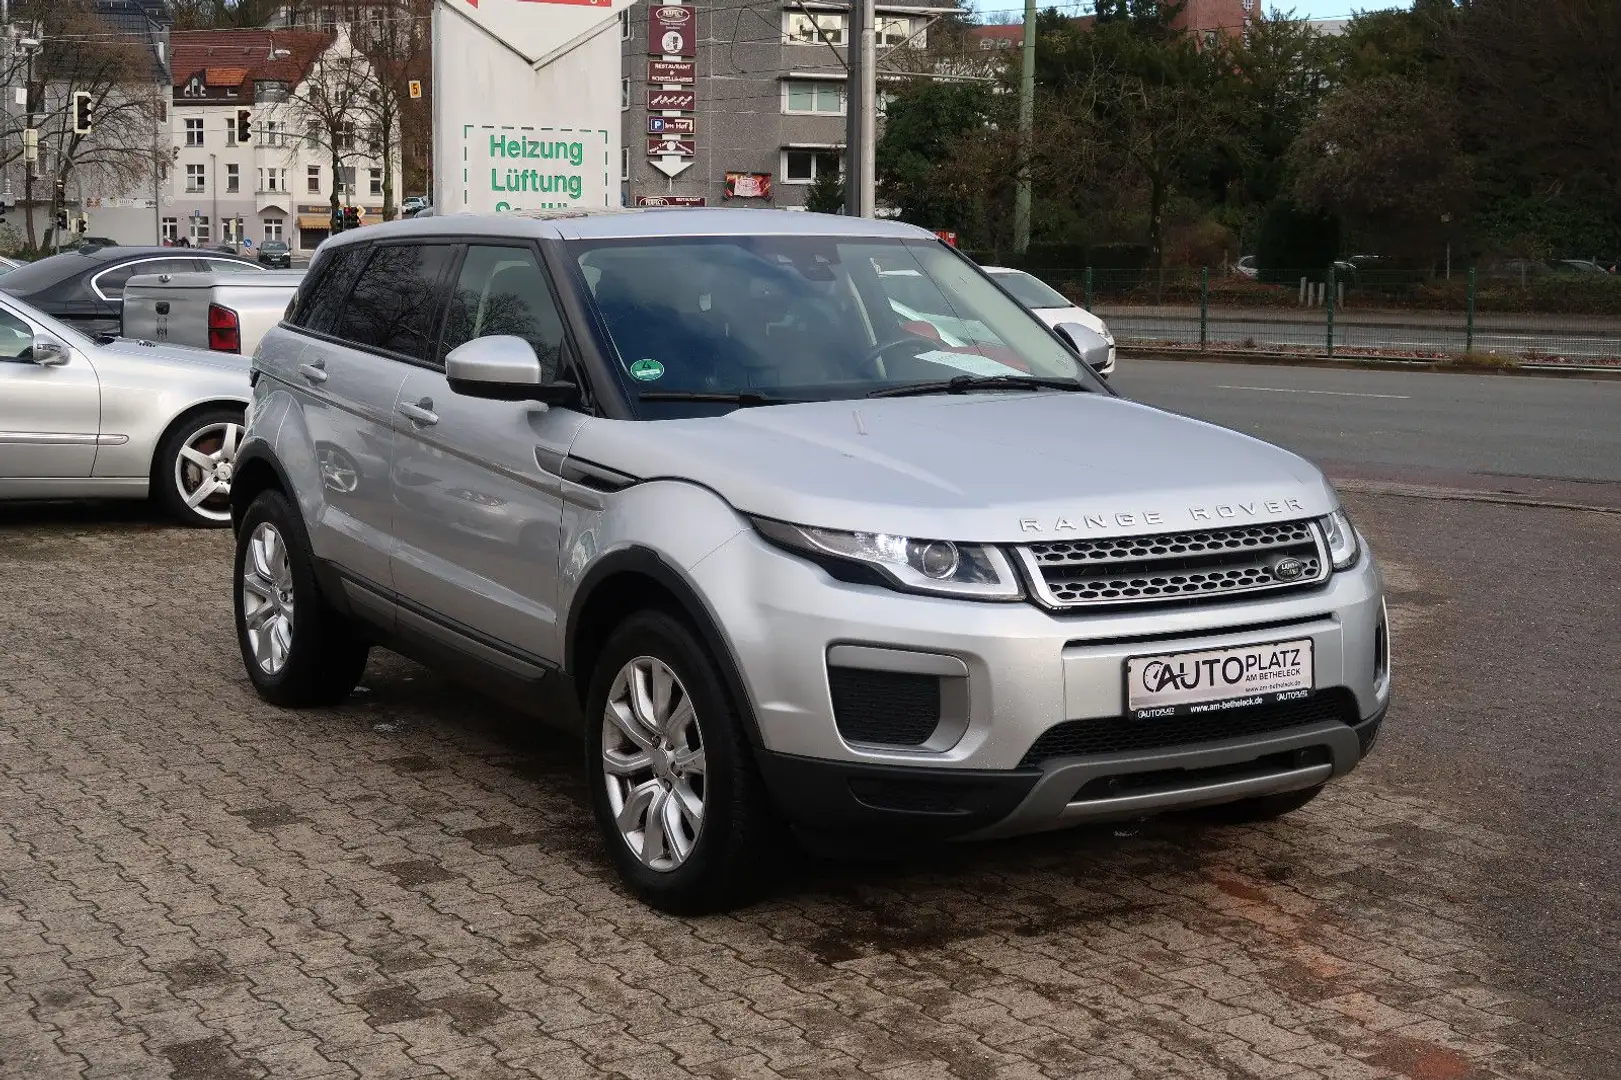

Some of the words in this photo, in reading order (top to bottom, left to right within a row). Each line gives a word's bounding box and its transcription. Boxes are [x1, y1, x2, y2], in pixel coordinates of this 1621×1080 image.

[489, 134, 583, 166] Heizung
[491, 168, 582, 199] Lüftung
[1019, 511, 1164, 532] RANGE
[1188, 499, 1304, 521] ROVER
[1245, 674, 1258, 682] AM
[1259, 668, 1301, 680] BETHELECK
[1190, 697, 1263, 713] www.am-betheleck.de
